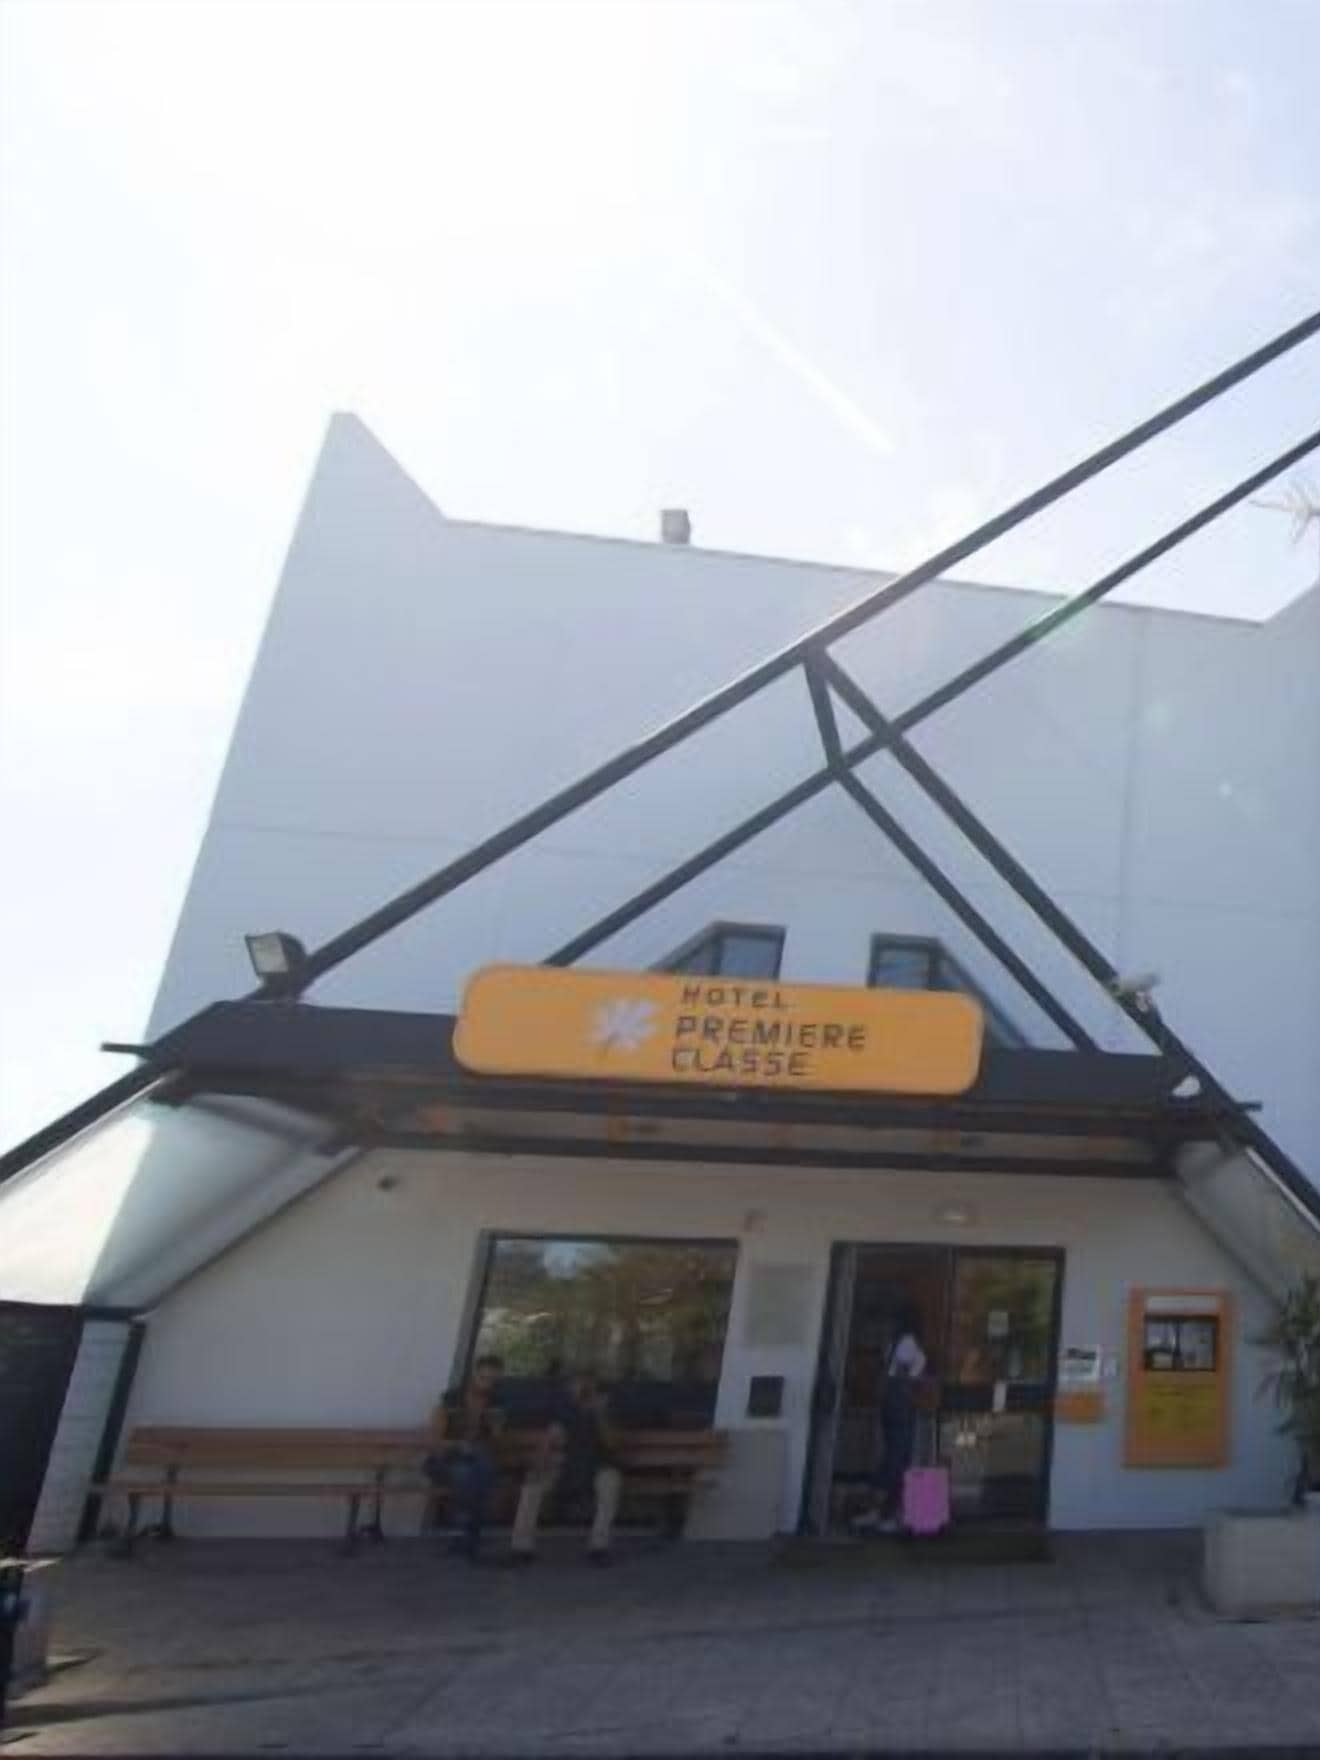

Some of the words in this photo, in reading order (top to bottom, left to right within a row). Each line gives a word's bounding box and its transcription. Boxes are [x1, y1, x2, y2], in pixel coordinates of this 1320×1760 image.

[682, 985, 794, 1009] HOTEL
[676, 1015, 867, 1051] PREMIERE
[672, 1046, 811, 1077] CLASSE
